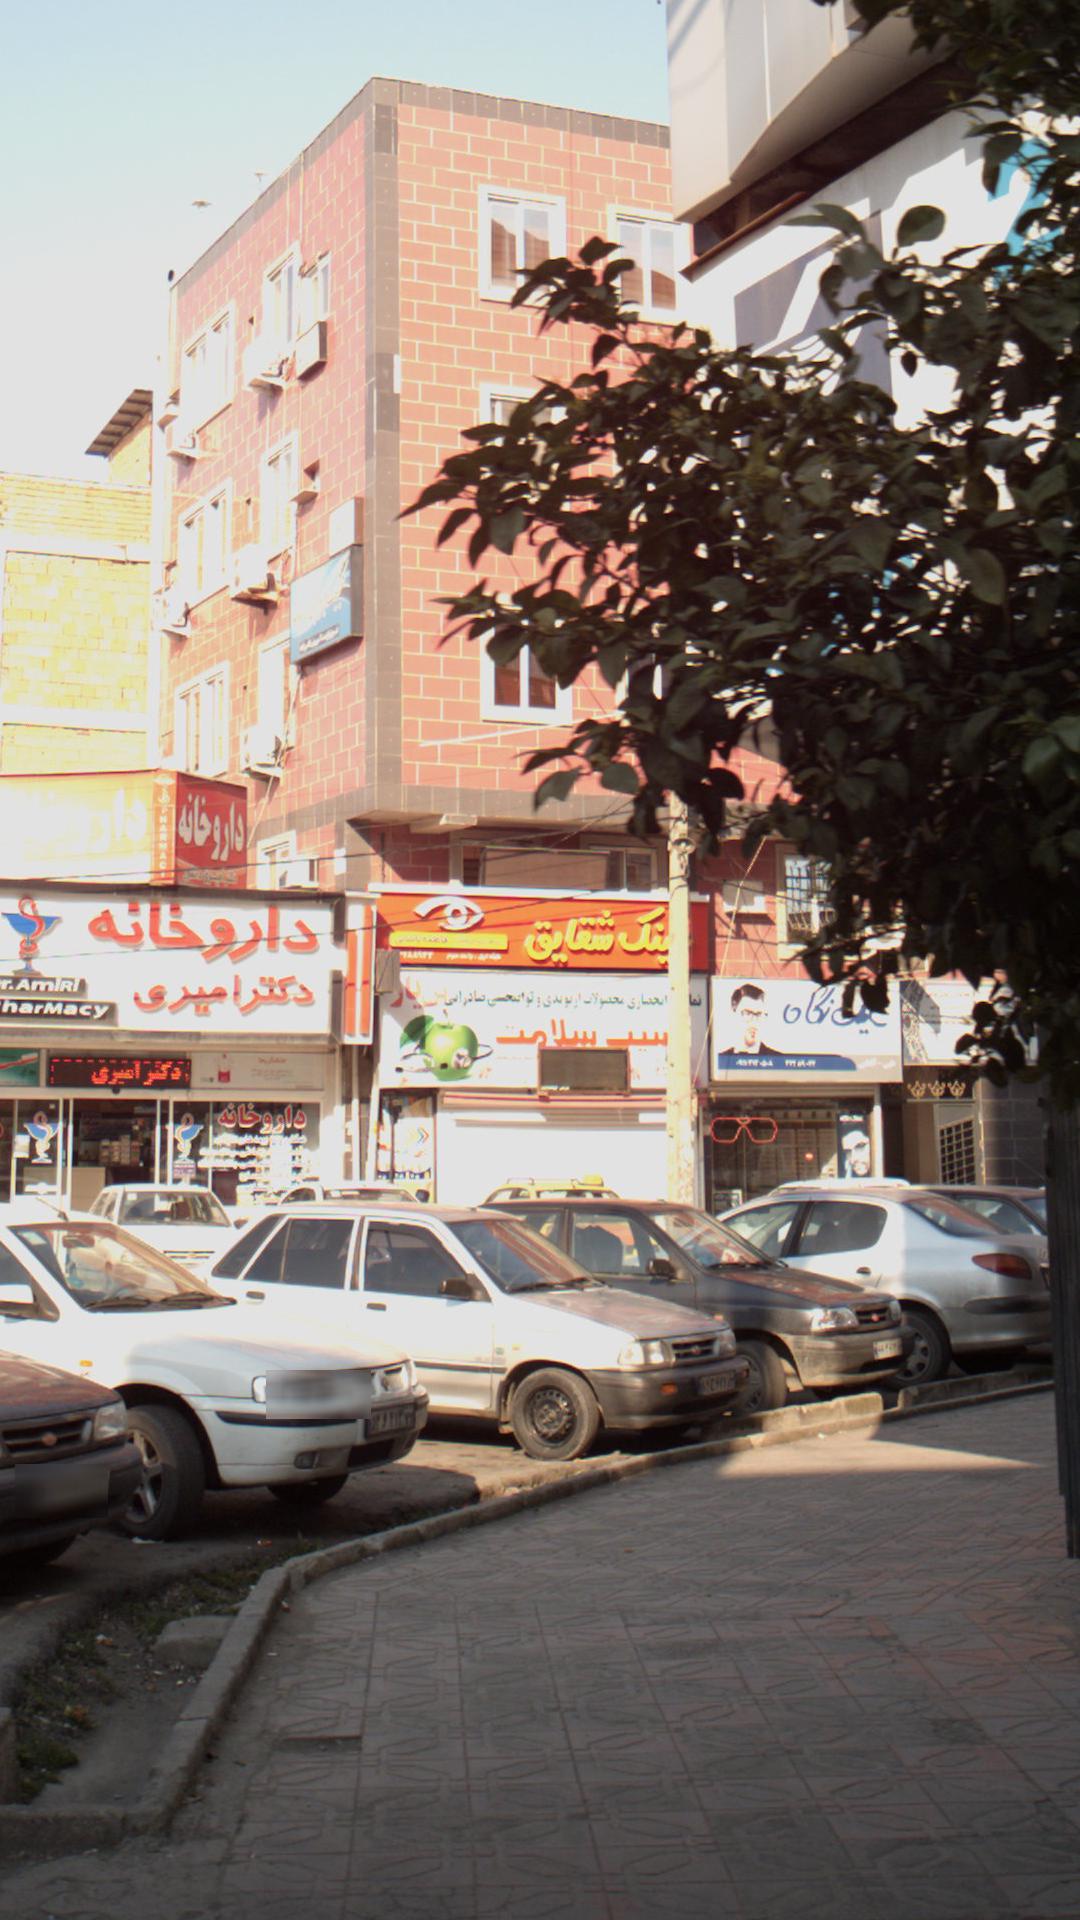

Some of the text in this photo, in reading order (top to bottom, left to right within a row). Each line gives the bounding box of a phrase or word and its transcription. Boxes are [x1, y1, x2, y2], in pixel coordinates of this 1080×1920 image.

[177, 793, 245, 862] داروخانه
[87, 900, 319, 963] داروخانه
[524, 907, 669, 965] ینک شقایق
[0, 1000, 109, 1019] harMacy
[133, 974, 315, 1017] دکتر امیری
[496, 1018, 597, 1047] سلامت
[91, 1060, 183, 1086] دکتر امیری
[217, 1102, 307, 1135] داروخانه
